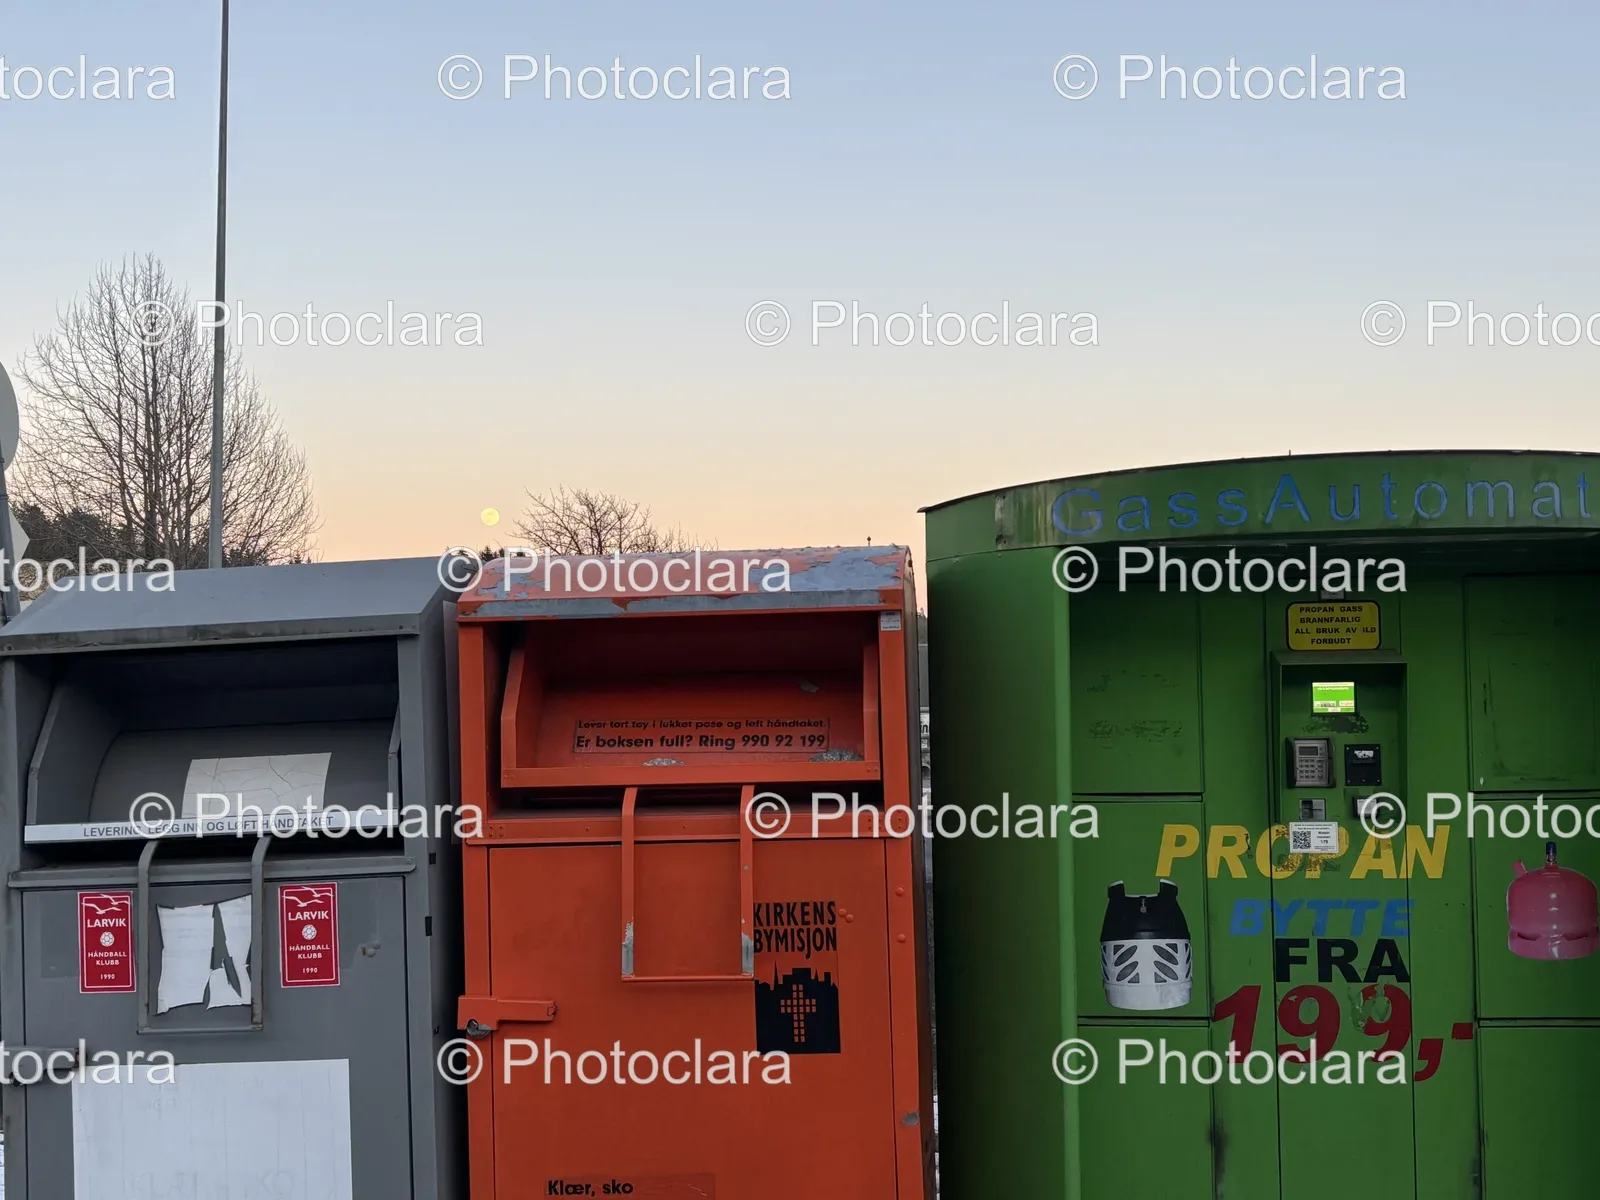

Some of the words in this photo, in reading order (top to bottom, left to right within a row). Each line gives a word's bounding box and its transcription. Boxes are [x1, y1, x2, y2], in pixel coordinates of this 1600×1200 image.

[1051, 472, 1592, 535] GassAutomat
[1300, 616, 1361, 624] BRANNFARLIG
[1311, 637, 1352, 645] FORBUDT
[727, 720, 742, 730] og
[576, 735, 591, 748] Er
[596, 734, 653, 748] boksen
[659, 734, 693, 747] full?
[699, 734, 736, 750] Ring
[741, 734, 769, 747] 990
[775, 734, 793, 747] 92
[800, 734, 826, 747] 199
[183, 822, 203, 832] IN
[207, 821, 224, 831] OG
[1155, 824, 1450, 879] PROPAN
[288, 910, 329, 920] LARVIK
[753, 901, 836, 927] KIRKENS
[1229, 899, 1414, 937] BYTTE
[87, 918, 127, 928] LARVIK
[289, 944, 330, 952] HÅNDBALL
[753, 927, 837, 959] BYMISJON
[88, 950, 127, 958] HÅNDBALL
[1274, 938, 1411, 983] FRA
[547, 1180, 595, 1197] Klær,
[602, 1179, 634, 1194] sko
